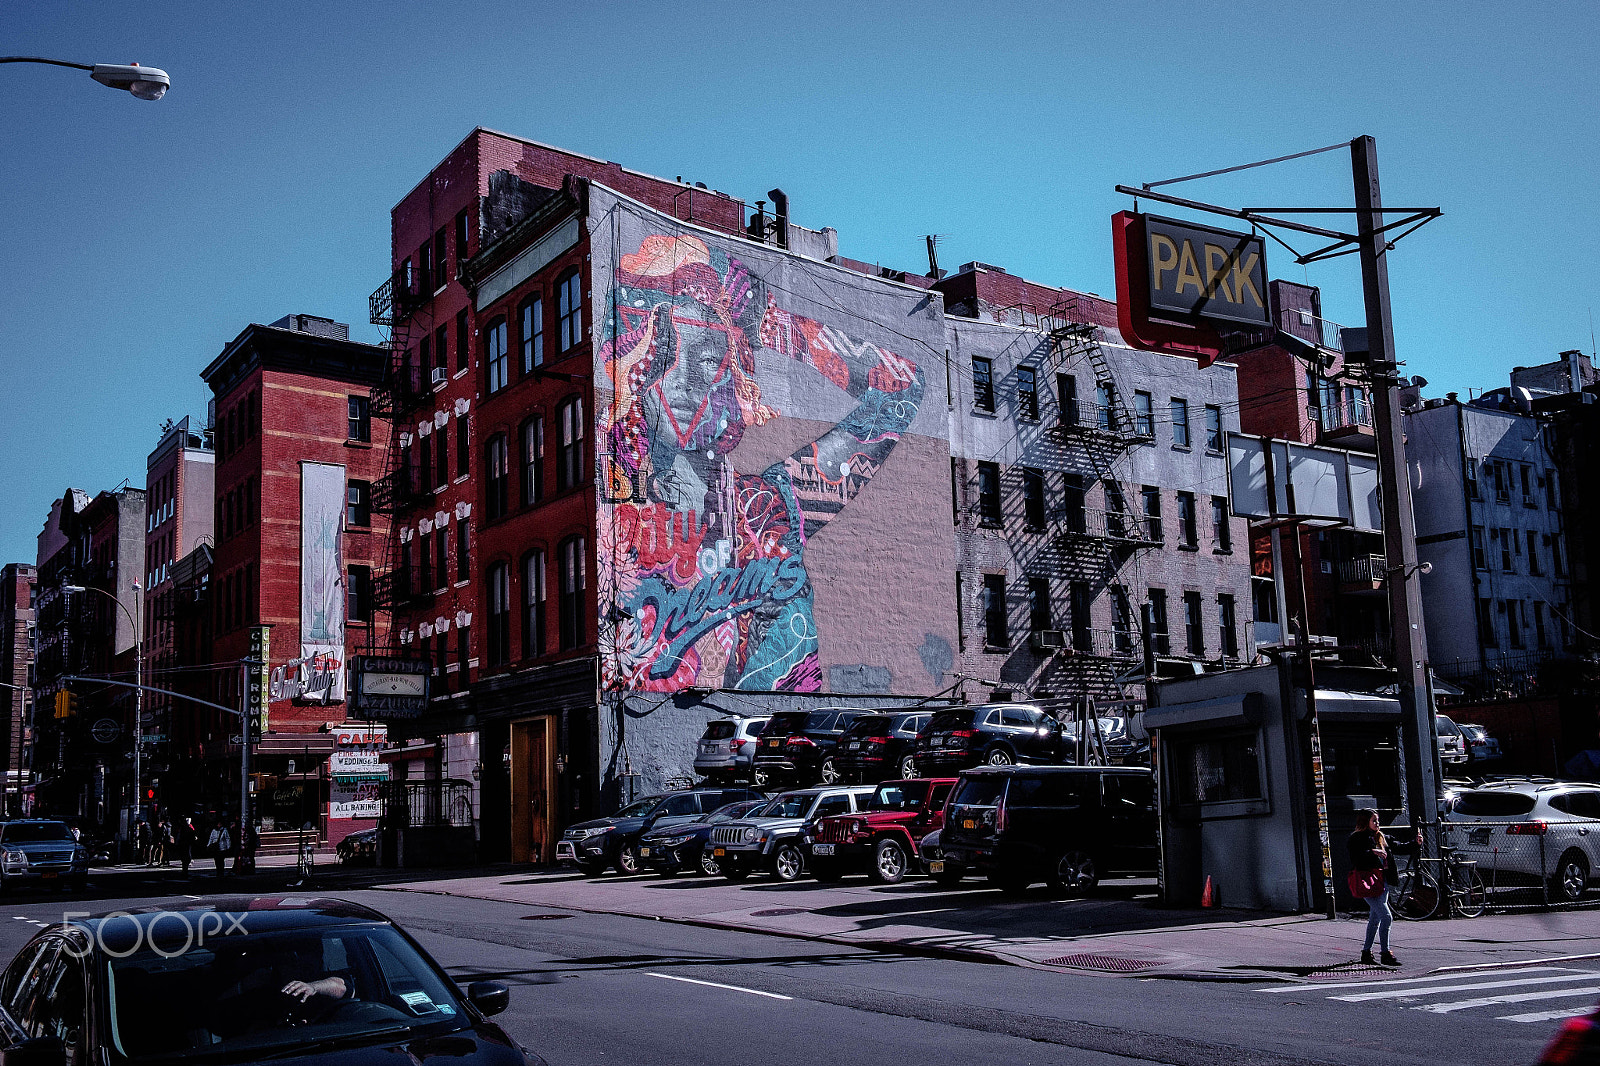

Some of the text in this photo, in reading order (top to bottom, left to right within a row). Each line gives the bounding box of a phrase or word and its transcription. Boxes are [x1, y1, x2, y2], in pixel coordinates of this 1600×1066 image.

[1151, 232, 1264, 308] PARK
[614, 502, 708, 578] City
[630, 556, 807, 672] Dreams
[250, 683, 260, 727] ROMA
[336, 803, 350, 811] ALL
[359, 784, 380, 792] ATM
